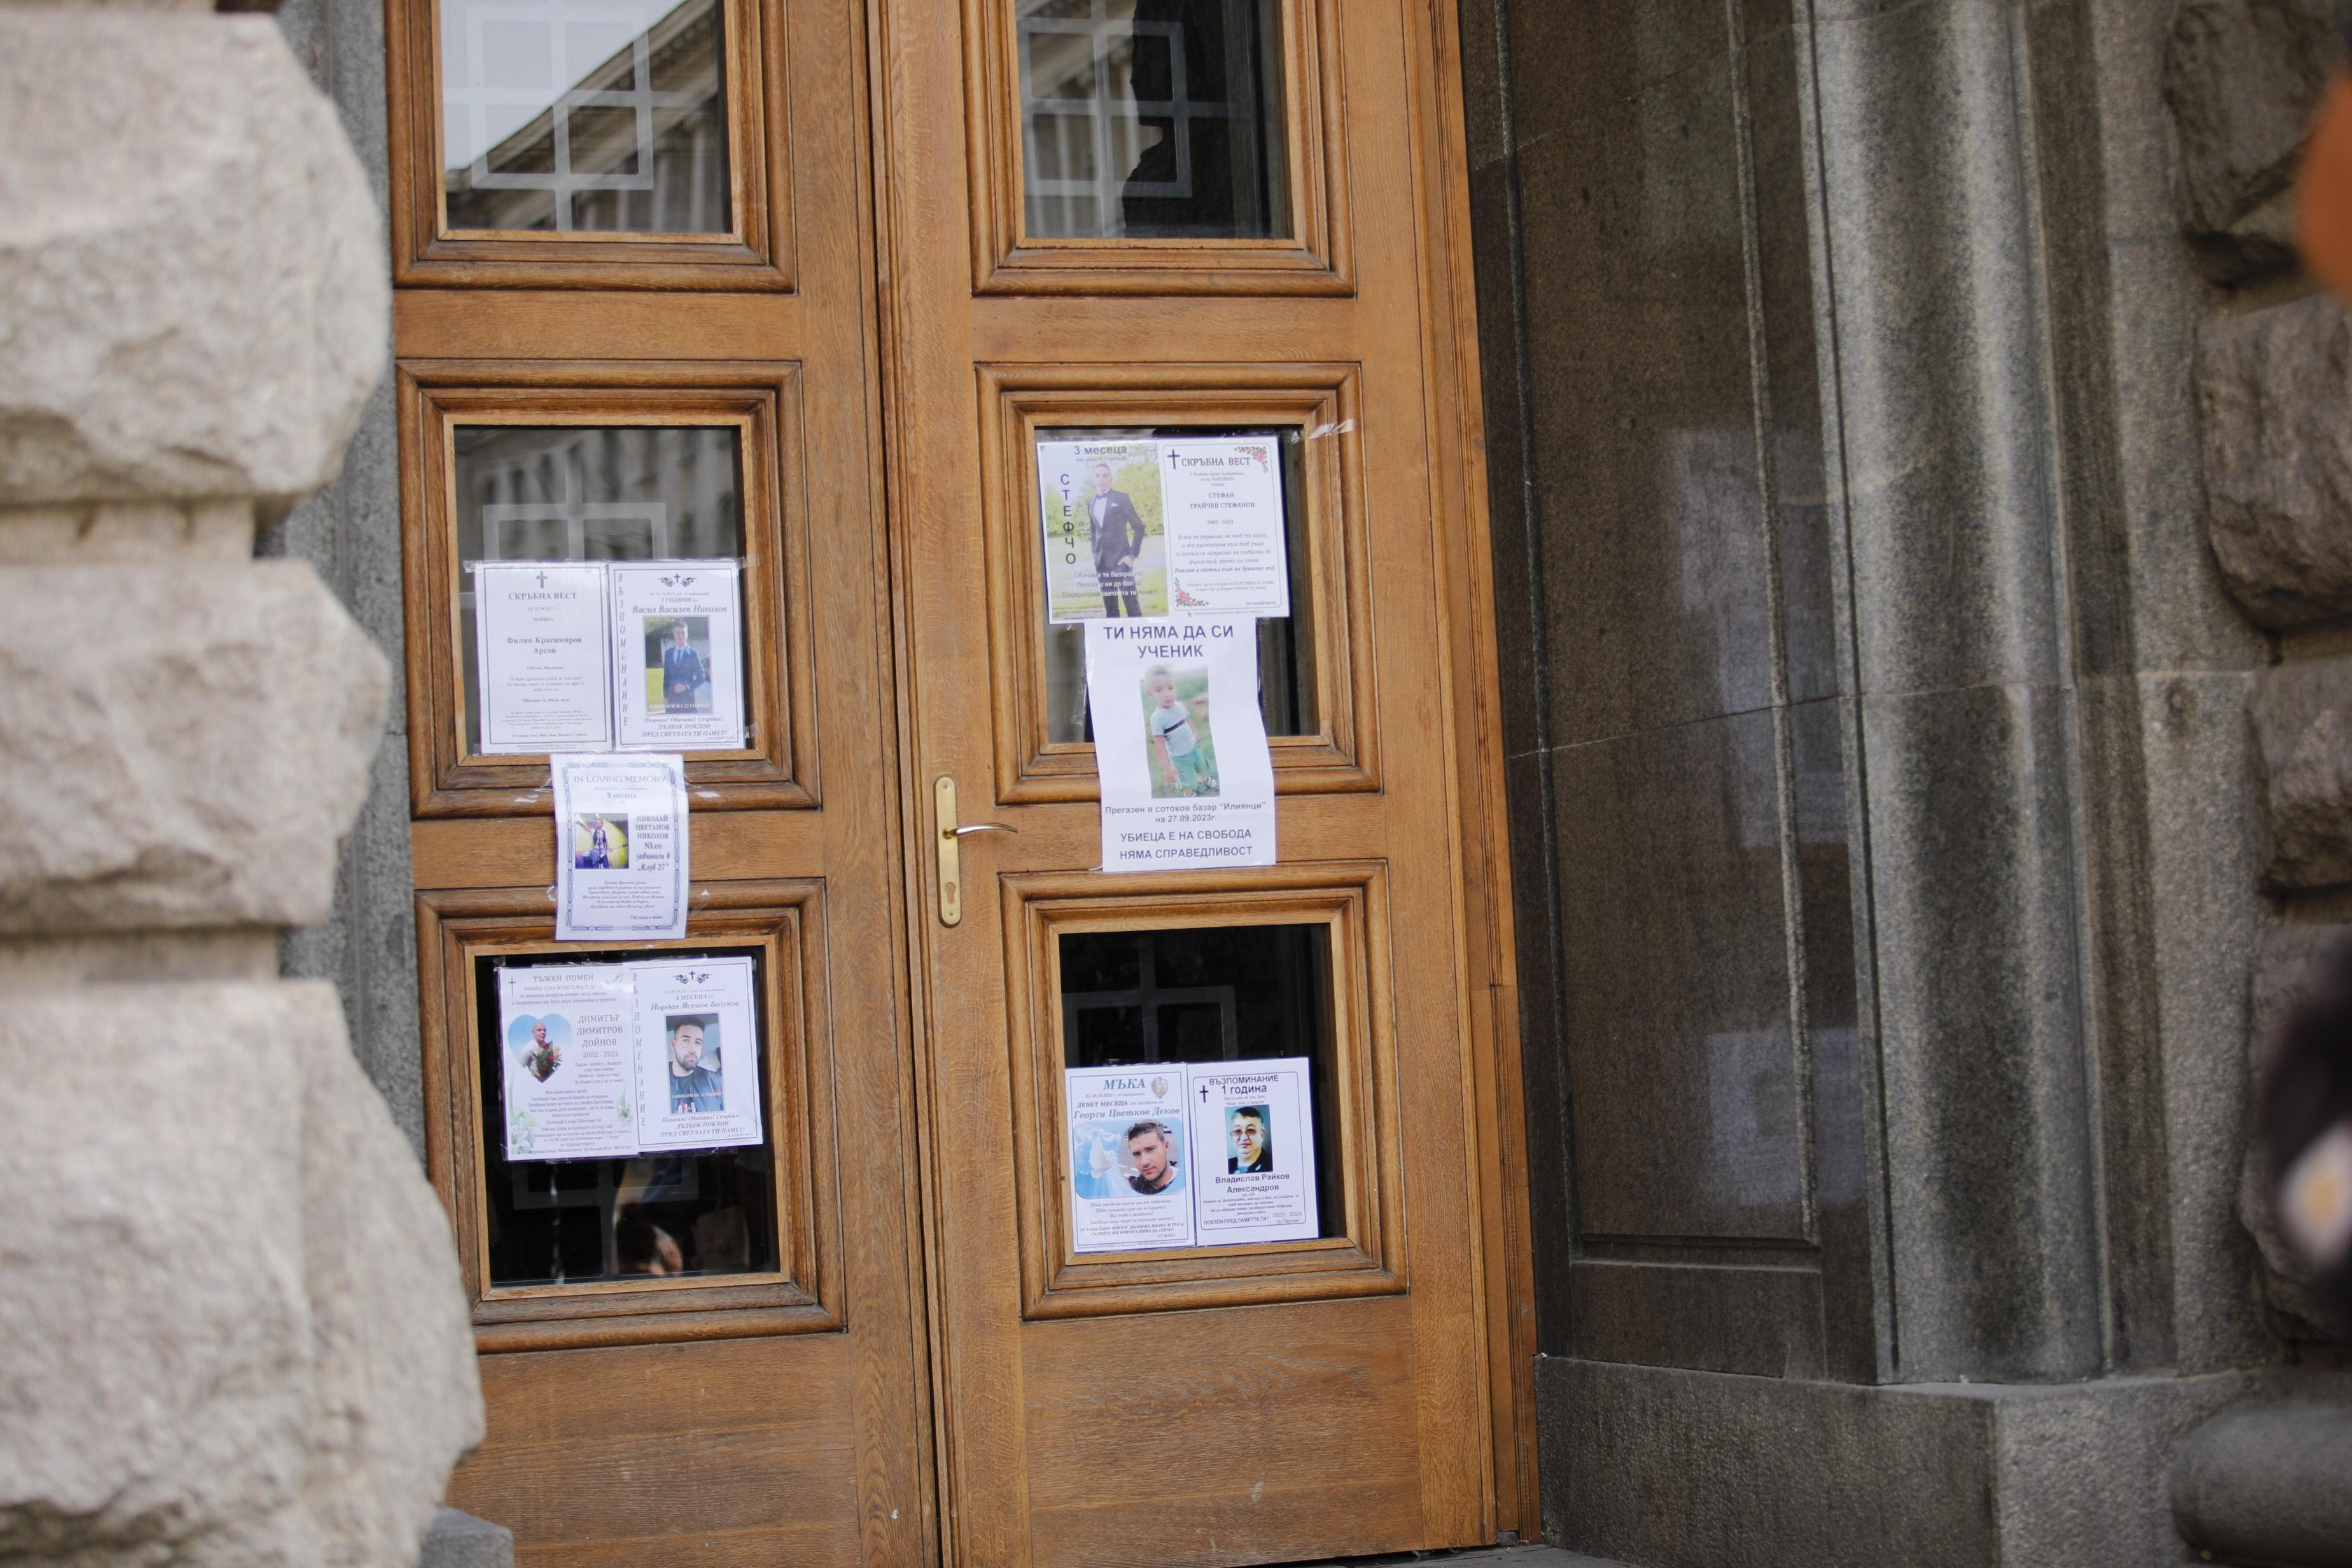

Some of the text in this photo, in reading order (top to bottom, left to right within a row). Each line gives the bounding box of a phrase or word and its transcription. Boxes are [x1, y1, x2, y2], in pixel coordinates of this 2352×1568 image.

[1074, 446, 1127, 455] 3 месеца
[1182, 457, 1250, 466] СКРЪБНА ВЕСТ
[632, 606, 656, 614] Васил
[1103, 625, 1233, 640] ТИ НЯМА ДА СИ
[1138, 645, 1203, 659] УЧЕНИК
[1105, 806, 1144, 815] Прегазен
[1193, 804, 1217, 812] базар
[1121, 829, 1252, 843] УБИЕЦА Е НА СВОБОДА
[1120, 846, 1252, 860] НЯМА СПРАВЕДЛИВОСТ
[650, 1002, 679, 1011] Йордан
[578, 1014, 620, 1023] ДИМИТЪР
[577, 1026, 623, 1036] ДИМИТРОВ
[582, 1038, 617, 1048] ДОЙНОВ
[1103, 1078, 1145, 1091] МЪКА
[1209, 1074, 1278, 1086] ВЪЗПОМИНАНИЕ
[1222, 1085, 1267, 1095] 1 година
[1074, 1107, 1180, 1120] Георги Цветков Деков
[1227, 1184, 1280, 1194] Александров
